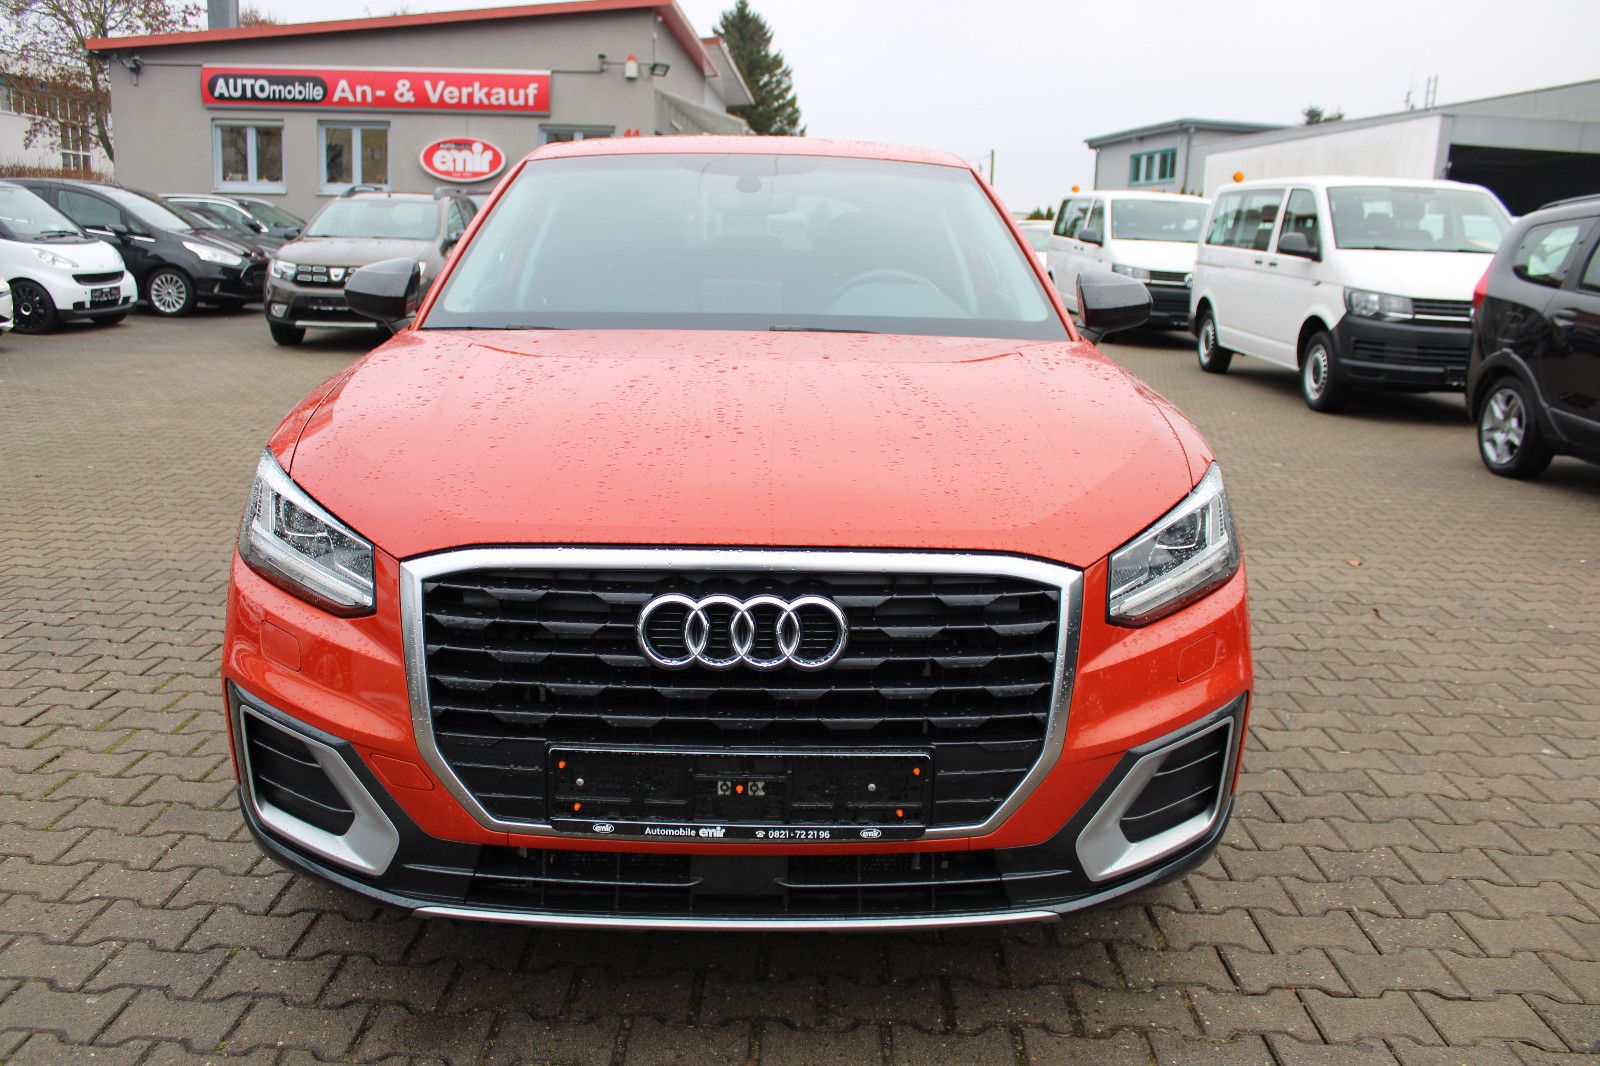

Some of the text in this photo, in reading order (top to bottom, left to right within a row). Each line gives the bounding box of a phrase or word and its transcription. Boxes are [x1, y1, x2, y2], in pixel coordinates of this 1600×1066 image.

[214, 77, 539, 107] AUTOmobile An- & Verkauf
[432, 142, 493, 172] emir
[594, 824, 612, 832] emir
[645, 826, 726, 838] Automobile emir
[861, 829, 880, 838] emir
